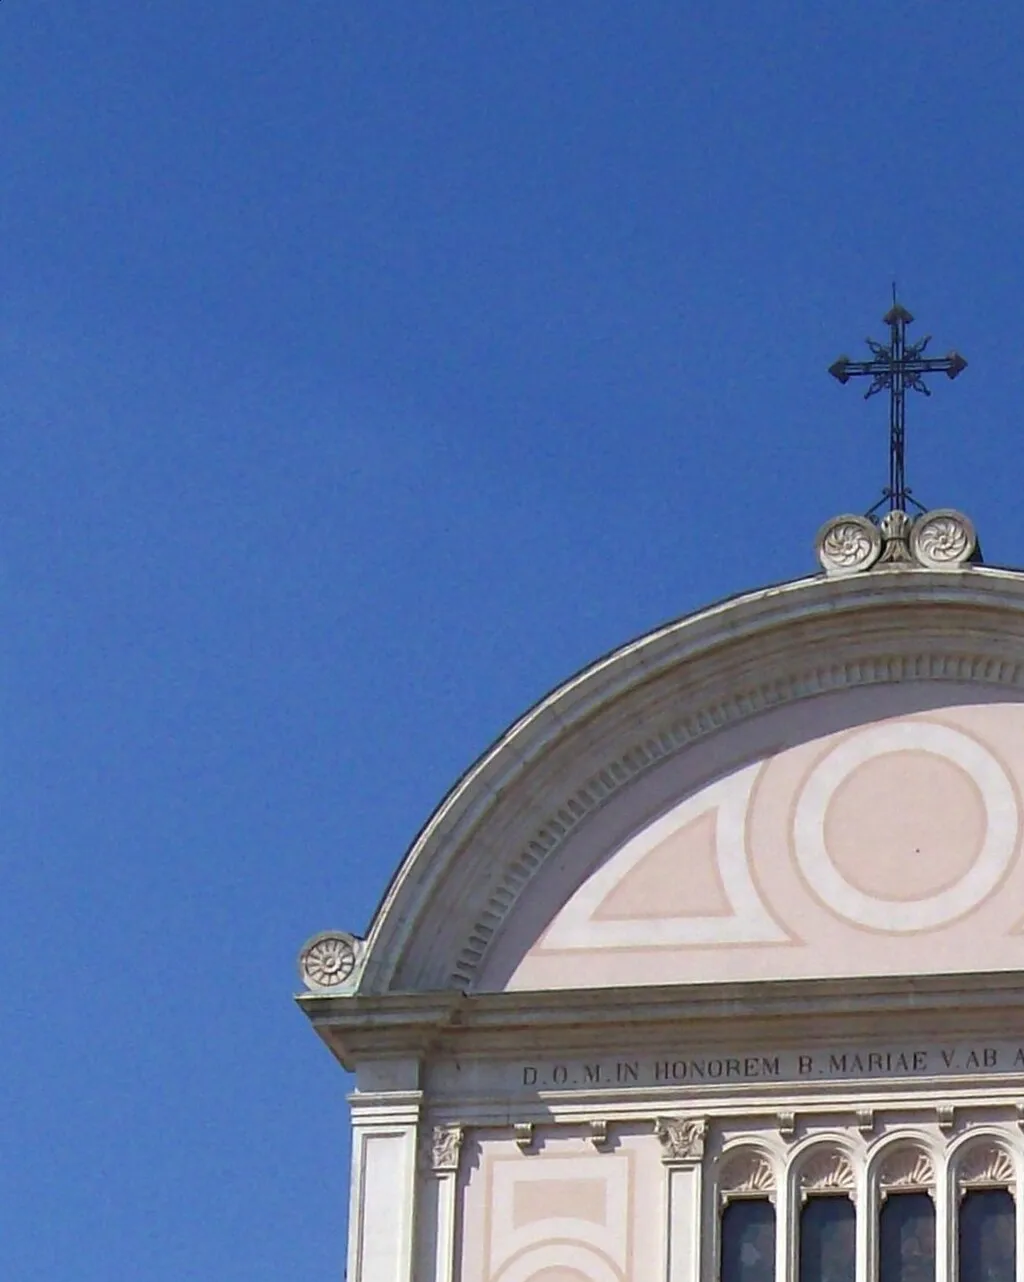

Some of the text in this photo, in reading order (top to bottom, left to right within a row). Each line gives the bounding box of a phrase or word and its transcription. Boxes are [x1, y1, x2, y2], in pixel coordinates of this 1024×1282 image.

[654, 1056, 780, 1080] HONOREM
[829, 1051, 927, 1074] MARIAE
[965, 1048, 998, 1069] AB
